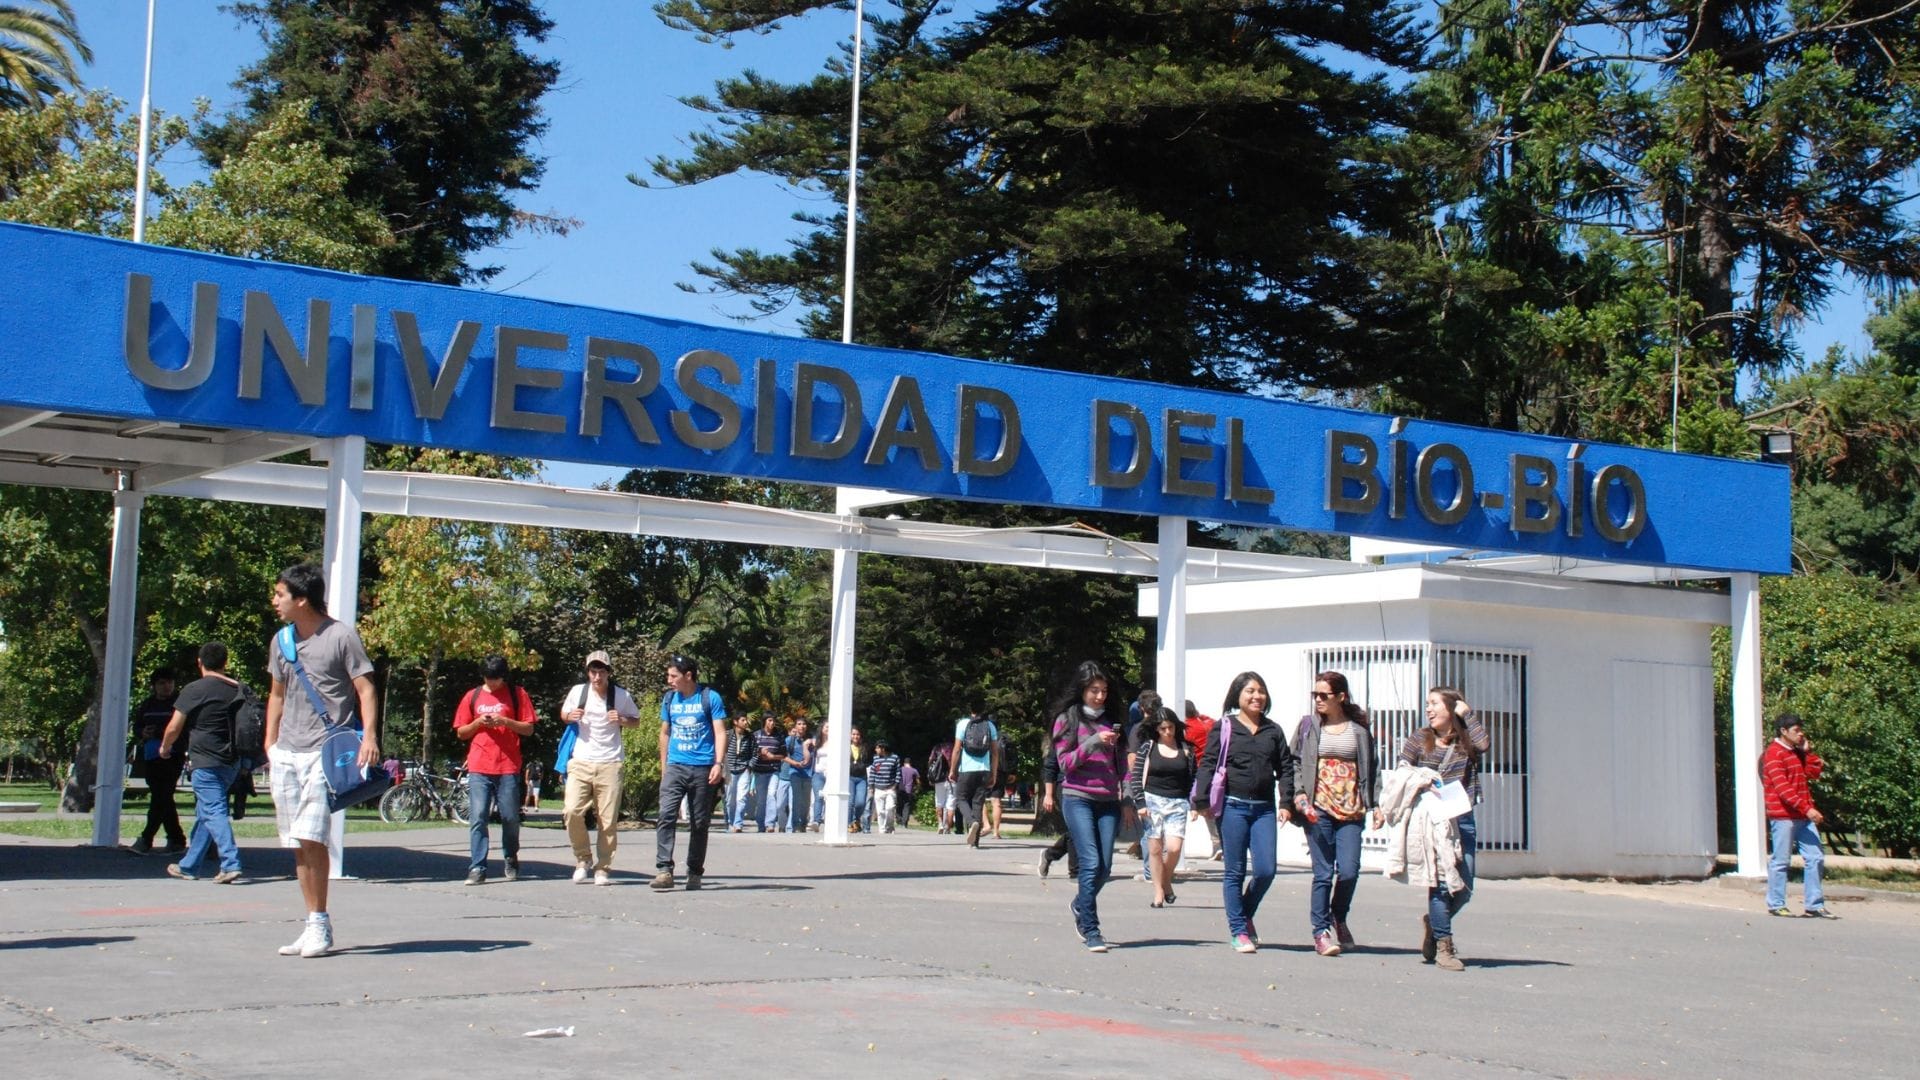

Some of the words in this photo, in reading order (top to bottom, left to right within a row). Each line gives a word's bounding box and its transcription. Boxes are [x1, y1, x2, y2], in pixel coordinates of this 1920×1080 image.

[124, 272, 1022, 478] UNIVERSIDAD
[1089, 399, 1275, 504] DEL
[1324, 416, 1646, 542] BÍO-BÍO
